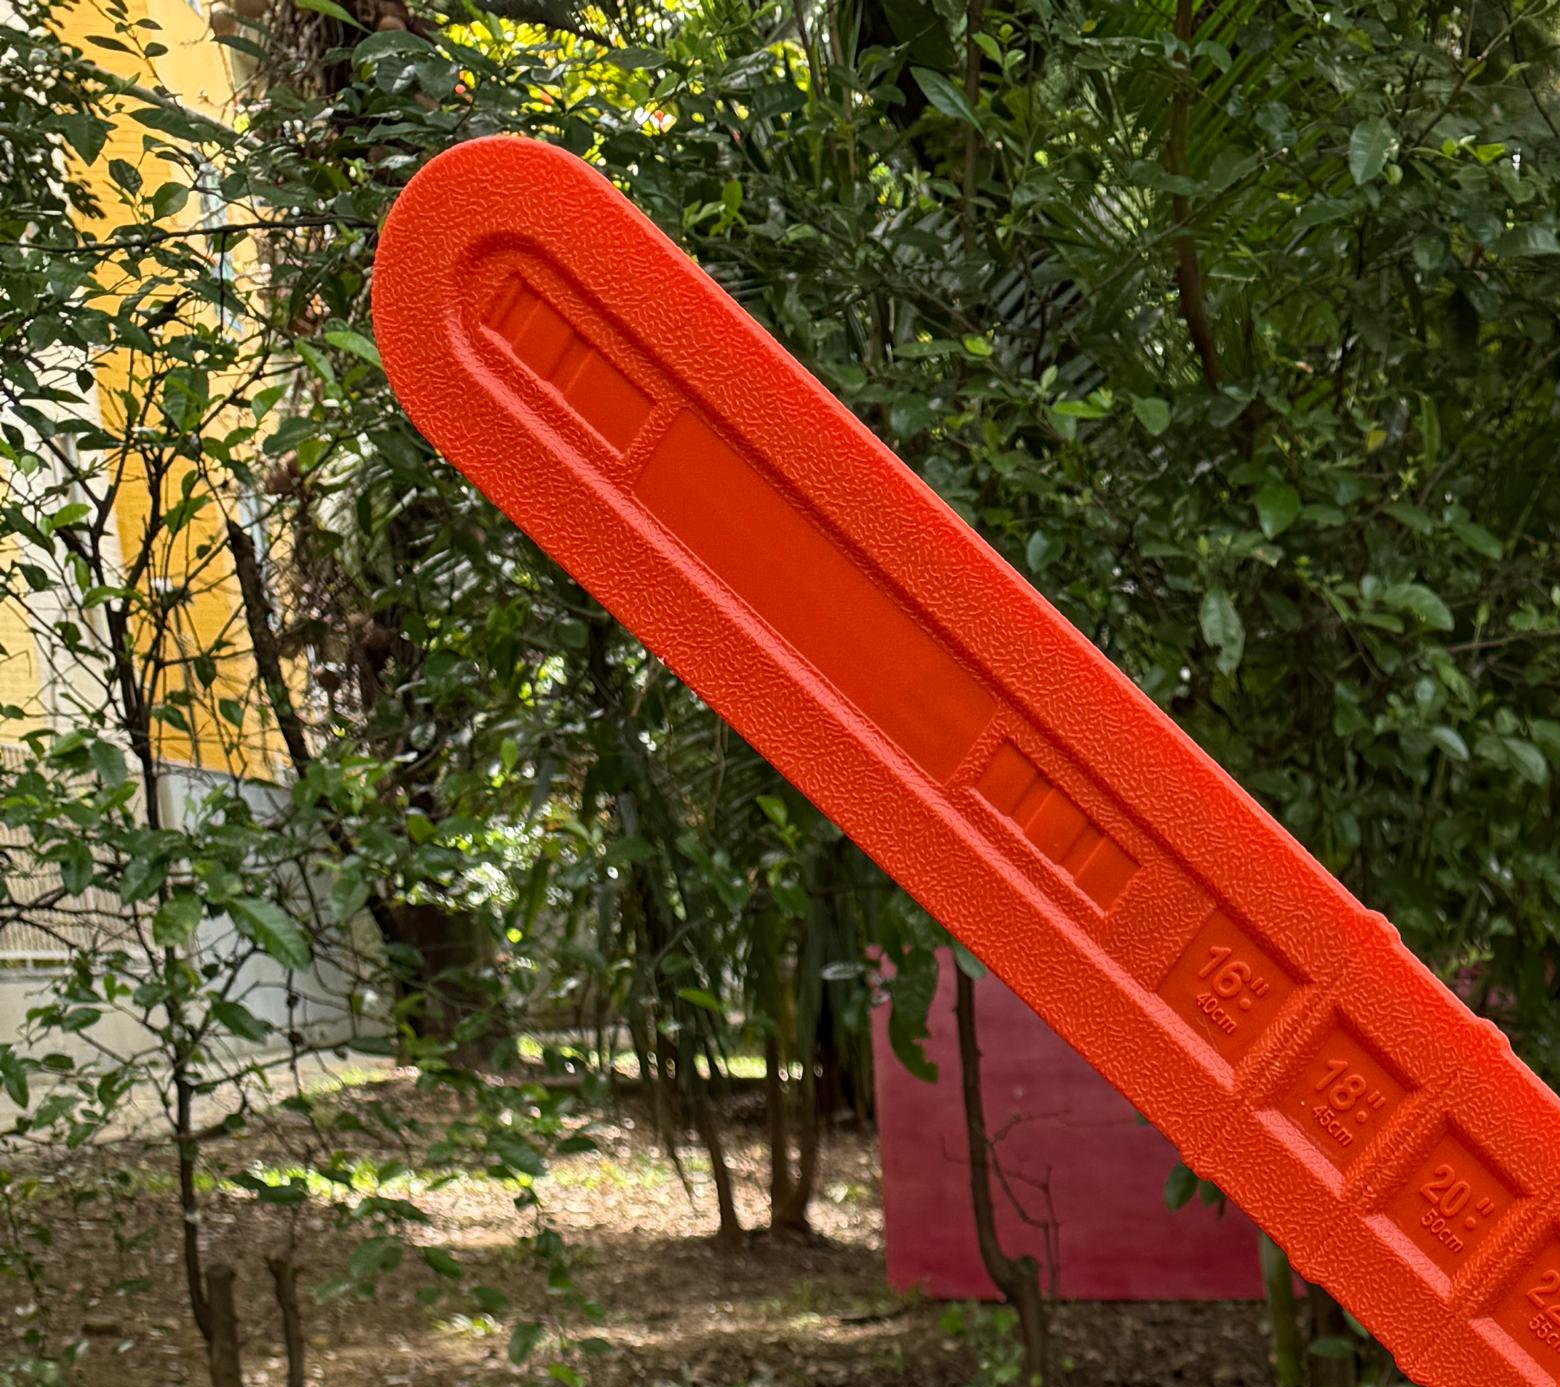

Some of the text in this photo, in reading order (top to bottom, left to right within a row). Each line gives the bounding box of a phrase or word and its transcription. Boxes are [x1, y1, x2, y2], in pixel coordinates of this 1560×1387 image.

[1196, 992, 1238, 1034] 40cm
[1312, 1105, 1353, 1147] 45cm
[1420, 1208, 1463, 1253] 50cm
